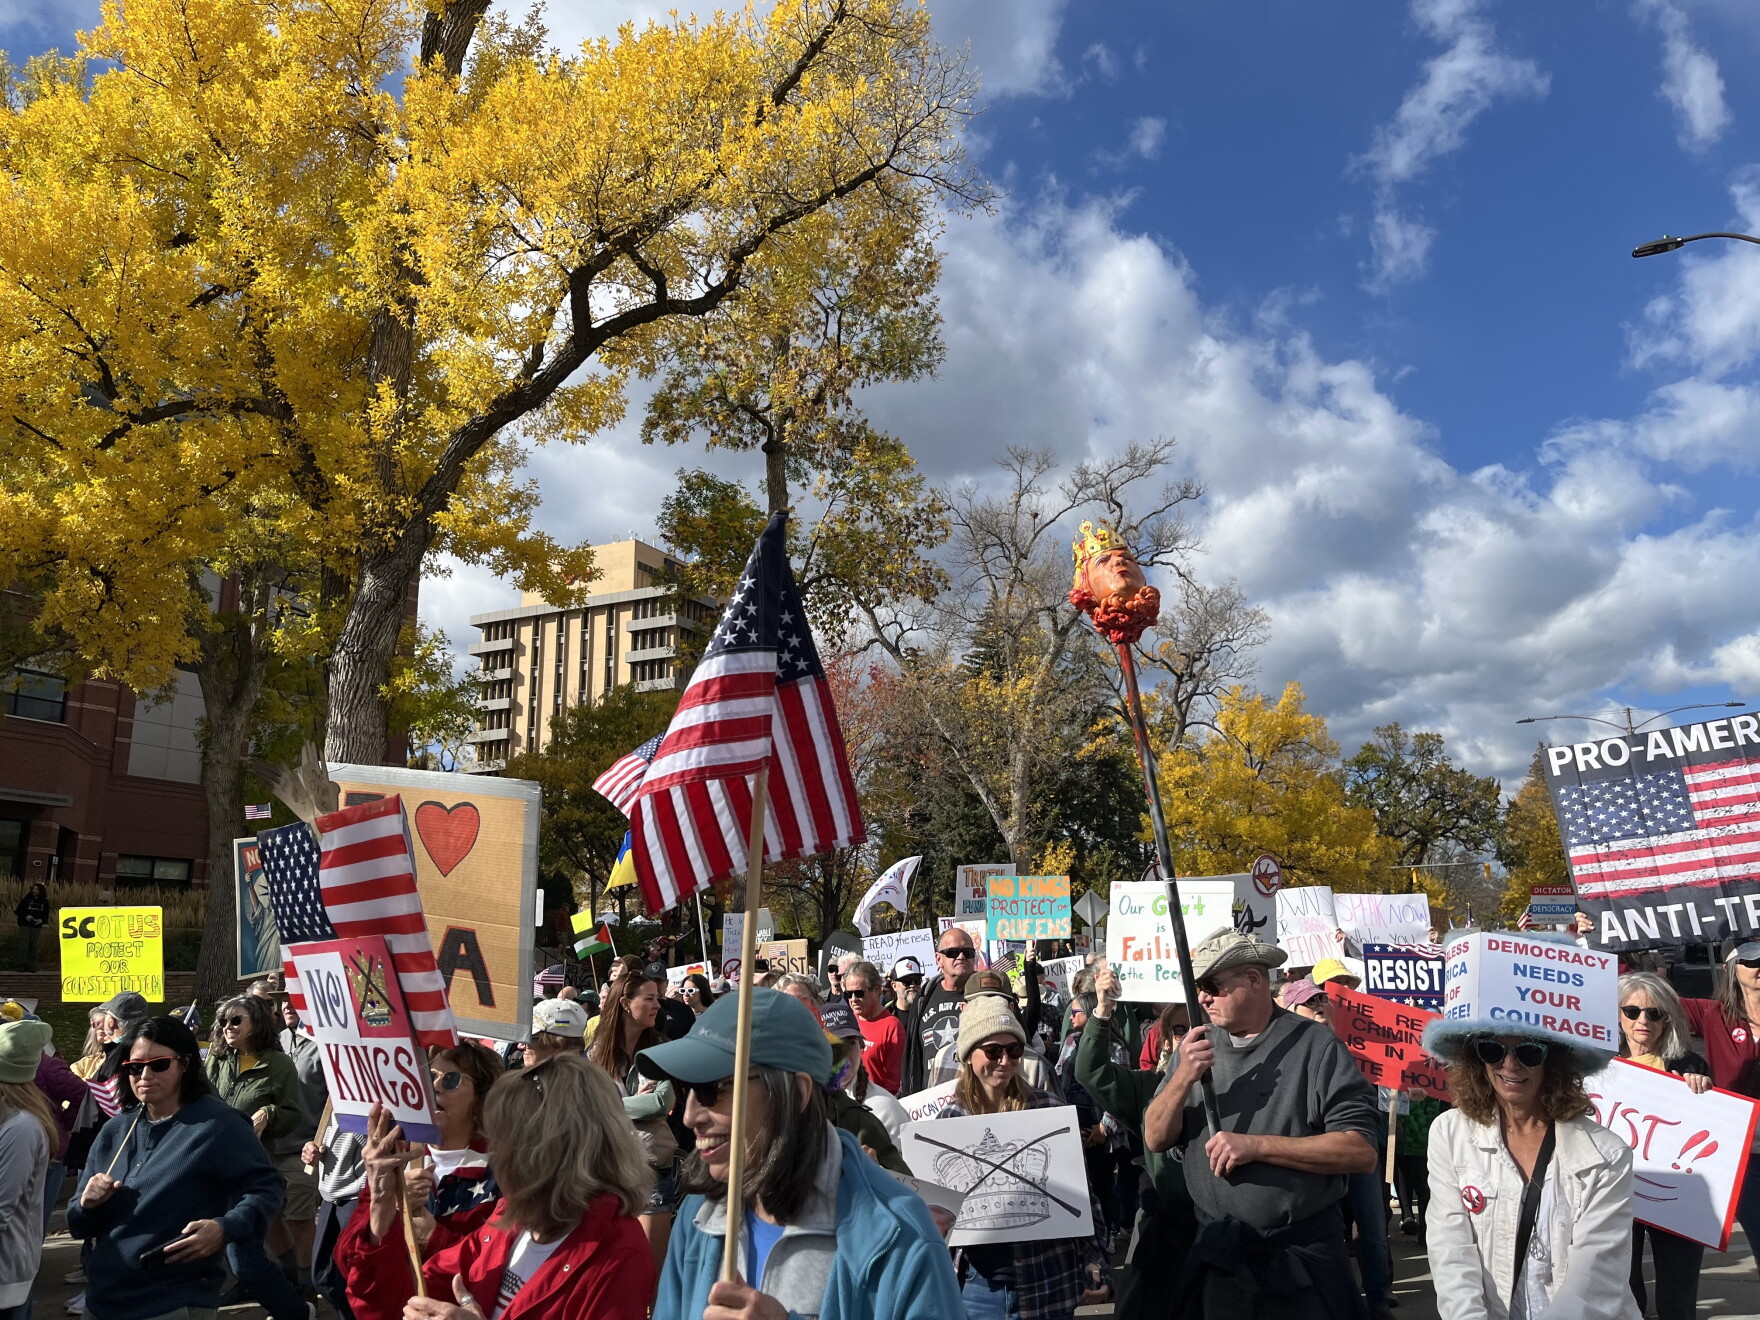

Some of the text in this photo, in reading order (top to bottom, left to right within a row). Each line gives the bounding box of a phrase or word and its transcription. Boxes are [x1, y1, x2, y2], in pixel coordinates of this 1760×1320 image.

[1547, 713, 1760, 777] PRO-AMER
[989, 878, 1014, 898] NO
[1019, 877, 1070, 898] KINGS
[1533, 887, 1572, 895] DICTATOR
[991, 898, 1057, 917] PROTECT
[1119, 894, 1146, 916] Our
[1151, 894, 1206, 917] Gv't
[1336, 893, 1387, 928] SPEAK
[1389, 901, 1428, 924] NOW
[1532, 905, 1574, 913] DEMOCRACY
[61, 914, 161, 940] SCOTUS
[996, 917, 1071, 940] QUEENS
[1156, 921, 1166, 933] is
[86, 940, 144, 959] PROTECT
[869, 937, 894, 950] READ
[896, 935, 911, 949] the
[911, 933, 931, 944] news
[1121, 935, 1198, 962] Faili
[767, 953, 807, 975] ESIST
[867, 951, 893, 966] today
[1487, 938, 1610, 971] DEMOCRACY
[99, 960, 129, 974] OUR
[1050, 958, 1081, 976] KINGS!
[1127, 966, 1144, 980] the
[1367, 958, 1443, 991] RESIST
[1513, 962, 1584, 988] NEEDS
[62, 974, 161, 997] CONSTITUTION
[304, 968, 348, 1029] NO
[1335, 993, 1374, 1019] THE
[1515, 985, 1582, 1012] YOUR
[820, 1009, 848, 1022] HARVARD
[921, 1007, 937, 1023] U.S.
[938, 1001, 954, 1012] AIR
[1351, 1017, 1423, 1047] CRIMIN
[1489, 1005, 1612, 1043] COURAGE!
[1347, 1033, 1367, 1051] IS
[1384, 1044, 1404, 1061] IN
[324, 1043, 424, 1111] KINGS
[1400, 1069, 1449, 1091] HOU
[922, 1101, 940, 1117] CAN
